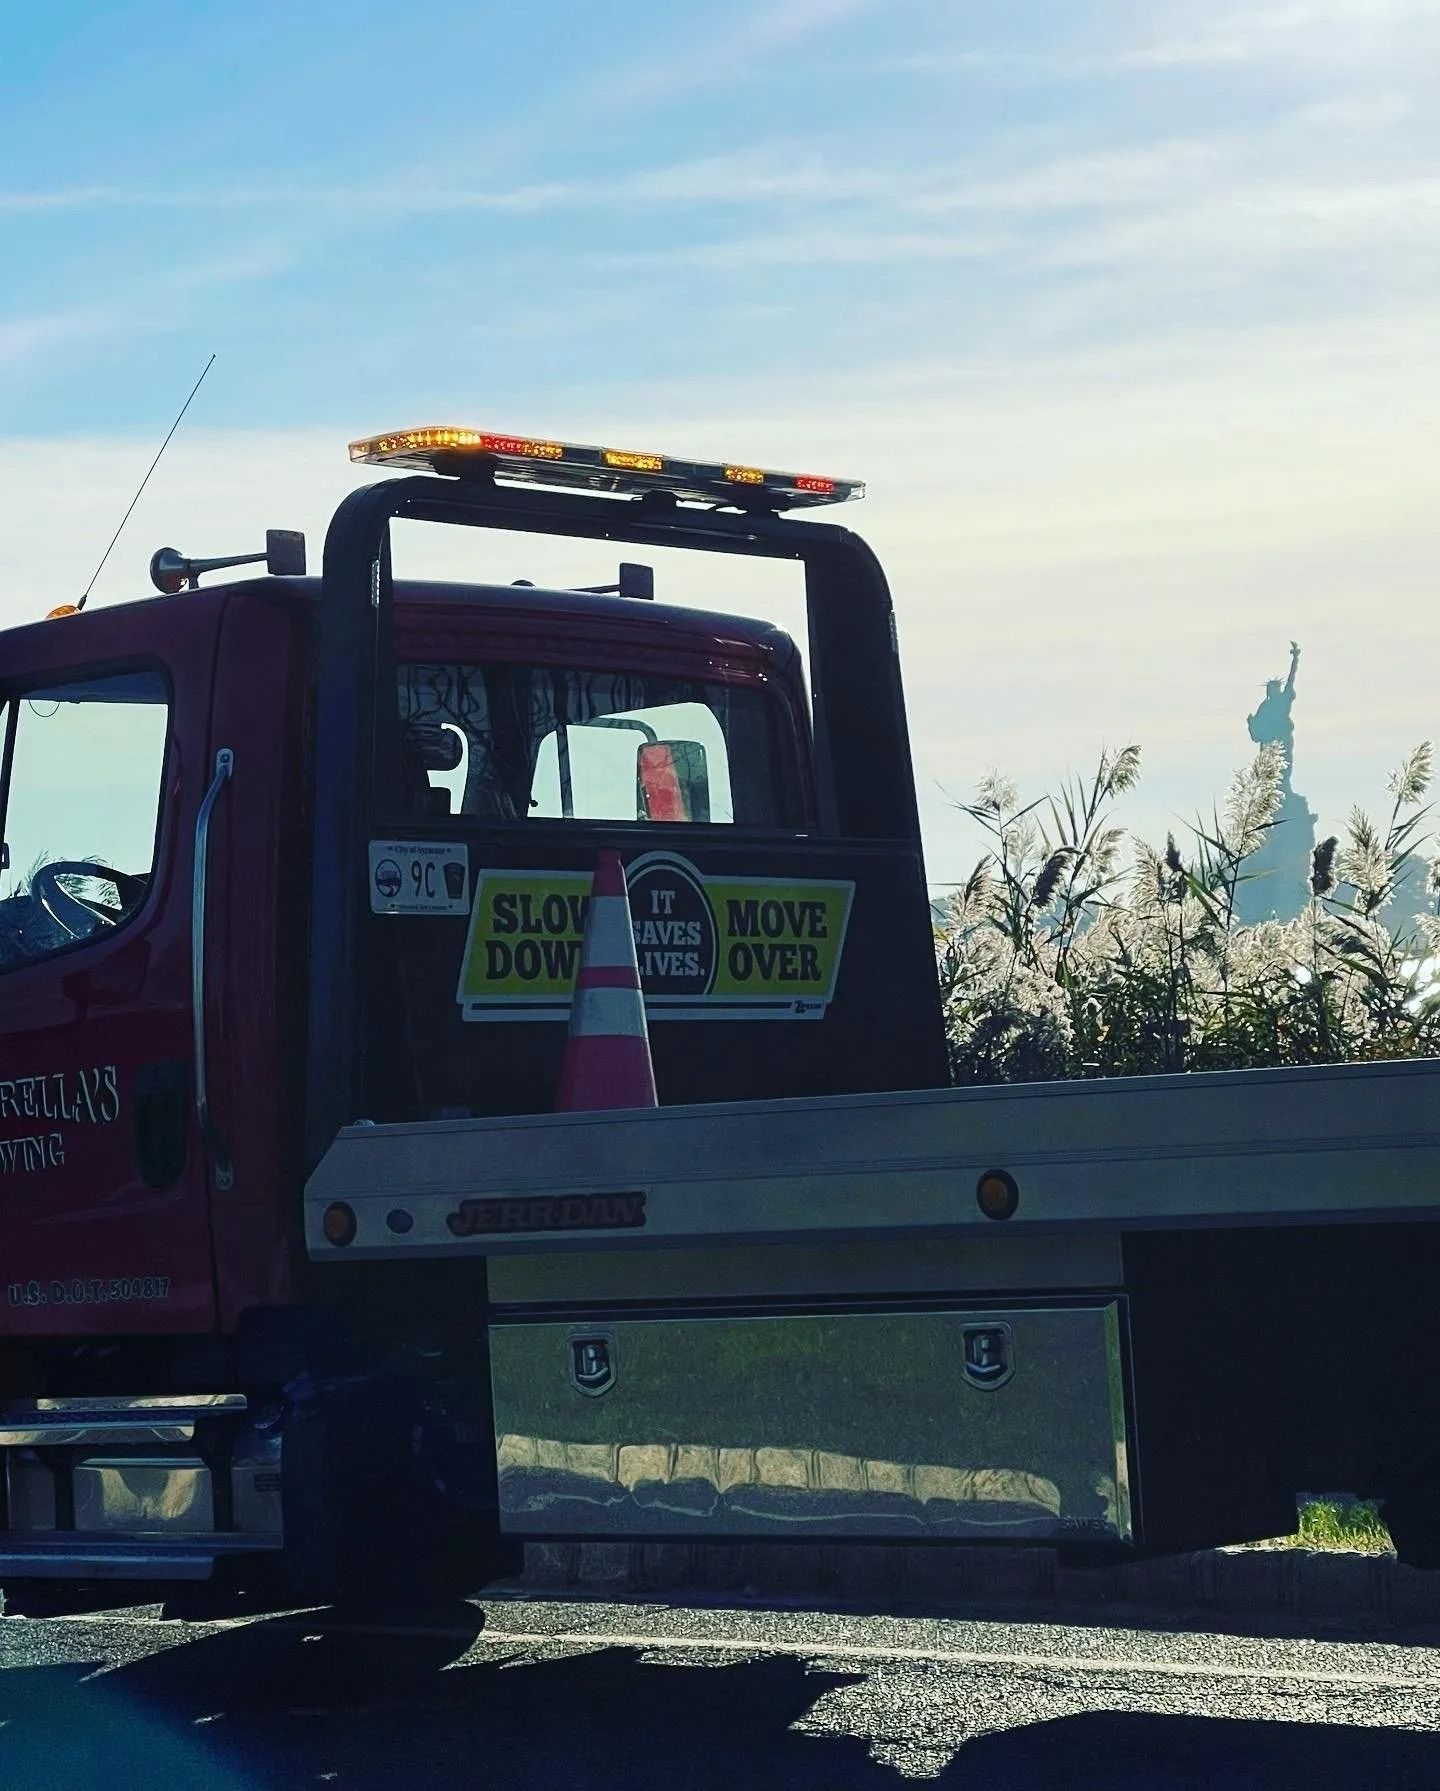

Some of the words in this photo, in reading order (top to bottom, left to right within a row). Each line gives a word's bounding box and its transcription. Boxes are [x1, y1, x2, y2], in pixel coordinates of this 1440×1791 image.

[651, 889, 676, 915] IT
[726, 899, 828, 938] MOVE
[486, 939, 584, 980] DOW
[639, 951, 705, 976] IVES.
[728, 942, 822, 981] OVER
